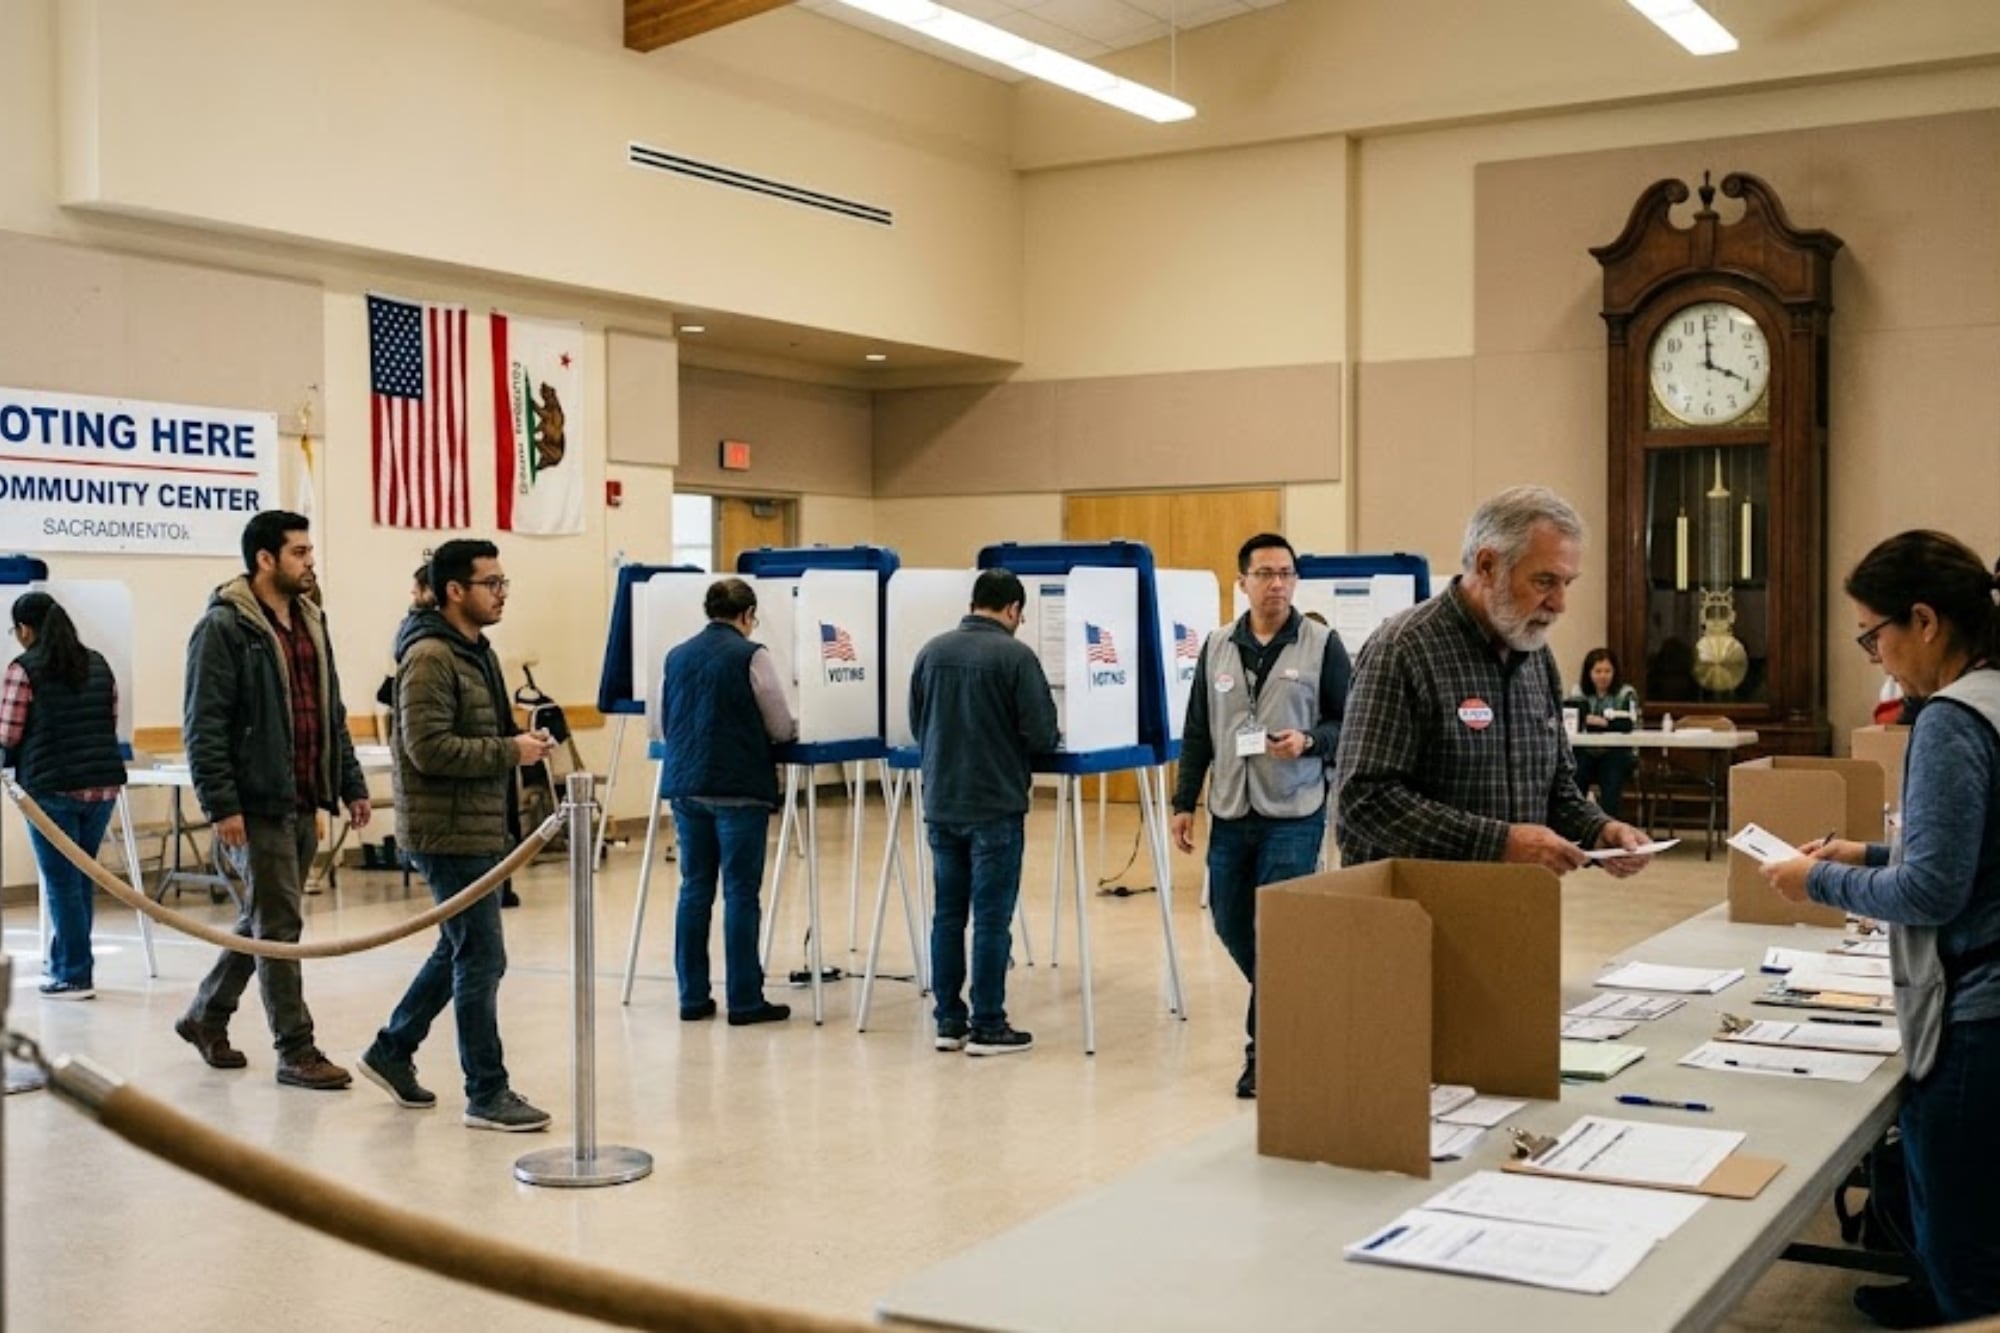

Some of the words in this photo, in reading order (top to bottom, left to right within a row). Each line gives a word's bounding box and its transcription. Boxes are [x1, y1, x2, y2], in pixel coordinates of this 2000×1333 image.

[0, 405, 136, 450] OTING
[152, 417, 255, 458] HERE
[158, 484, 260, 511] CENTER
